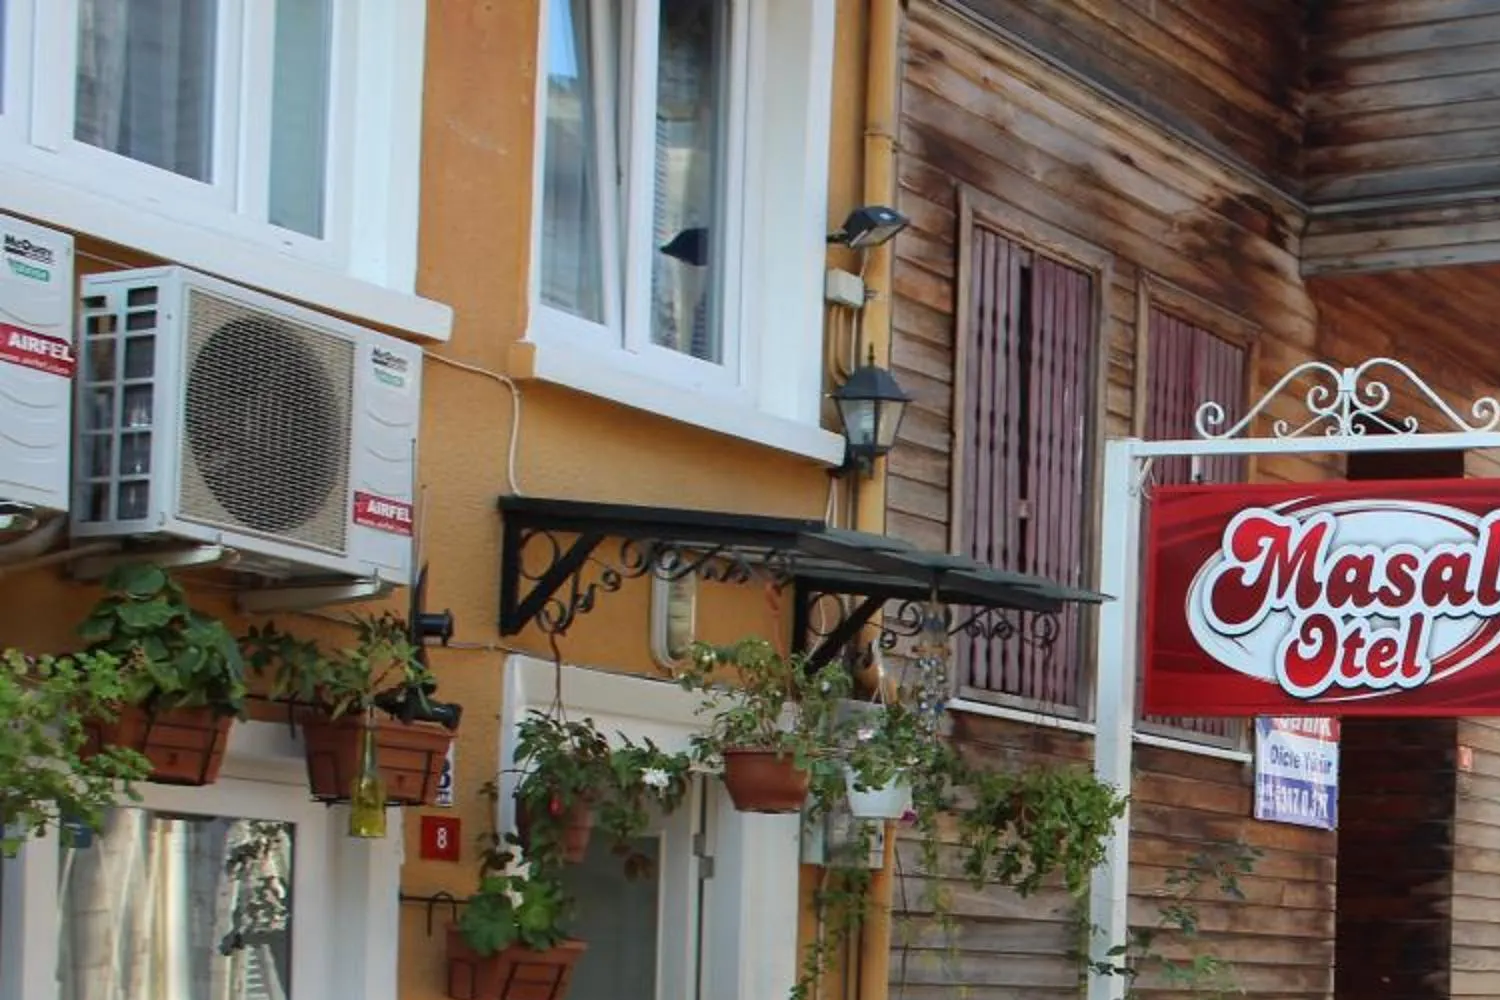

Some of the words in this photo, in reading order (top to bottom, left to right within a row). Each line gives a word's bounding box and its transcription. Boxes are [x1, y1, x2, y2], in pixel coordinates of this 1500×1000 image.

[7, 331, 75, 363] AIRFEL
[367, 499, 412, 523] AIRFEL
[1283, 611, 1426, 688] Otel
[436, 827, 448, 849] 8
